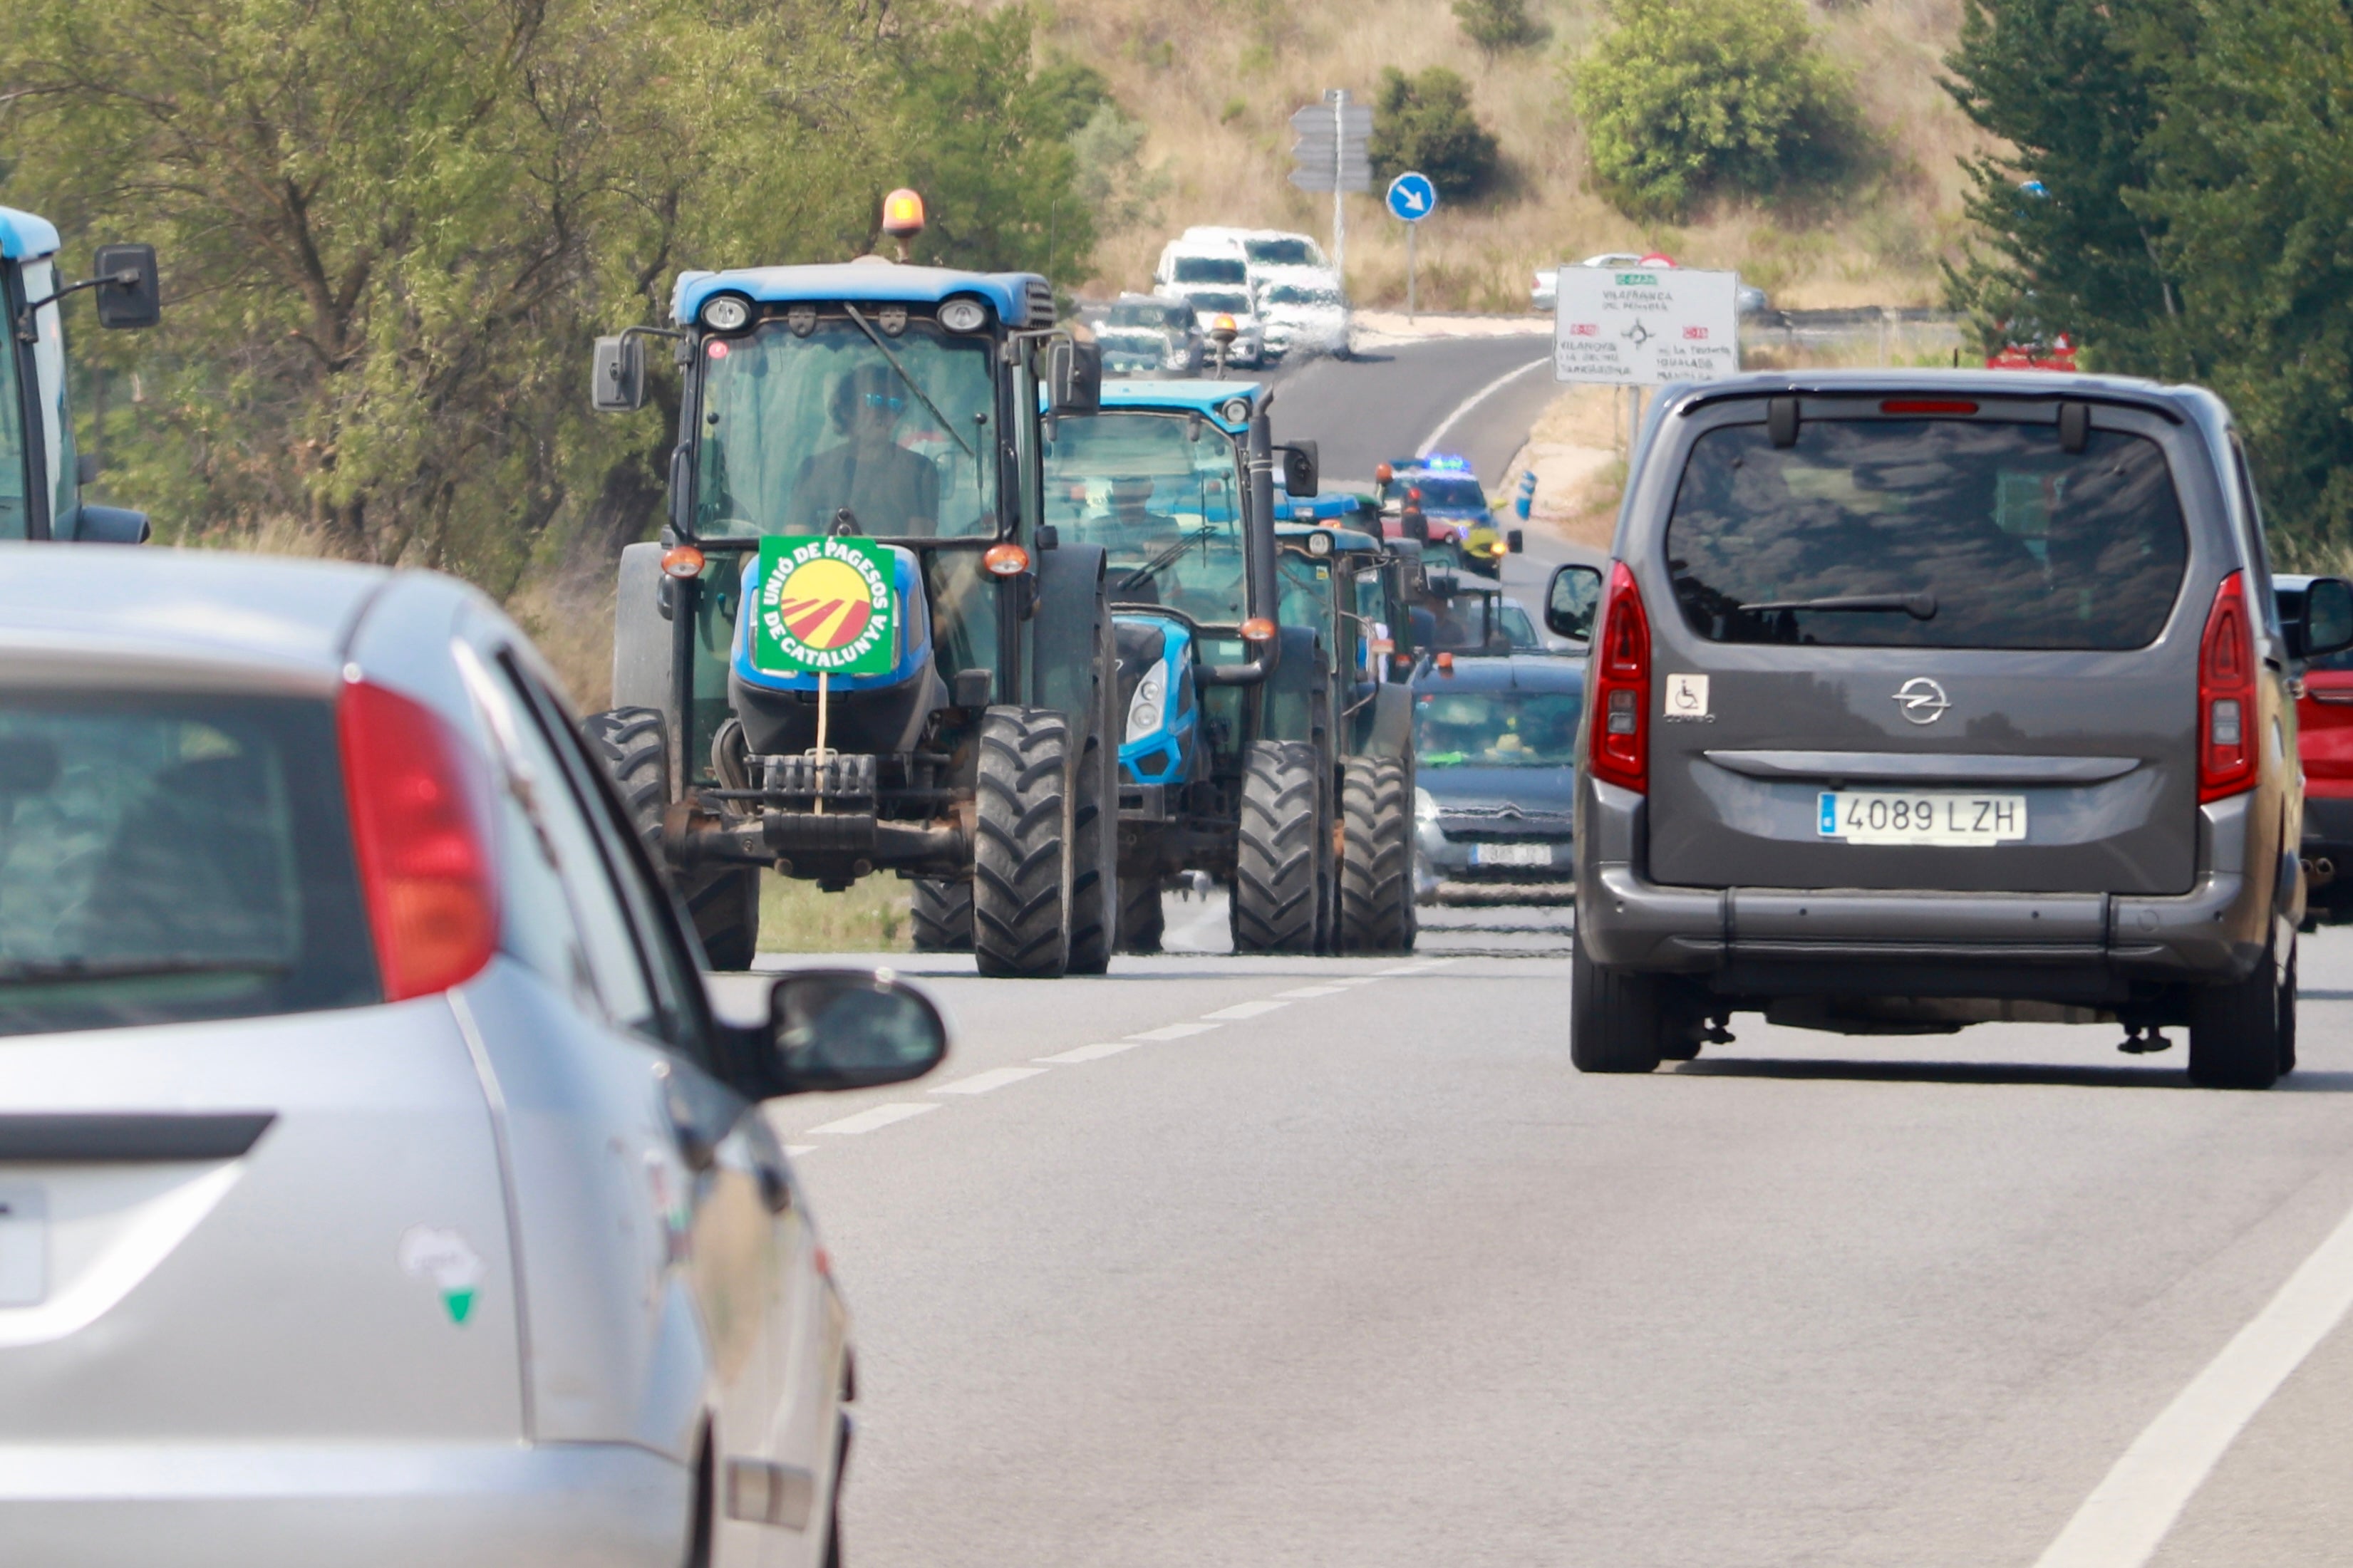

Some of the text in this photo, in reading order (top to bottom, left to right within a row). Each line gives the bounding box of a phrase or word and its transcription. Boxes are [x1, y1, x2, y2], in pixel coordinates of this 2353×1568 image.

[763, 540, 889, 610] UNIÓ DE PAGESOS
[763, 611, 888, 668] DE CATALUNYA
[1846, 797, 1933, 831] 4089
[1948, 800, 2015, 832] LZH
